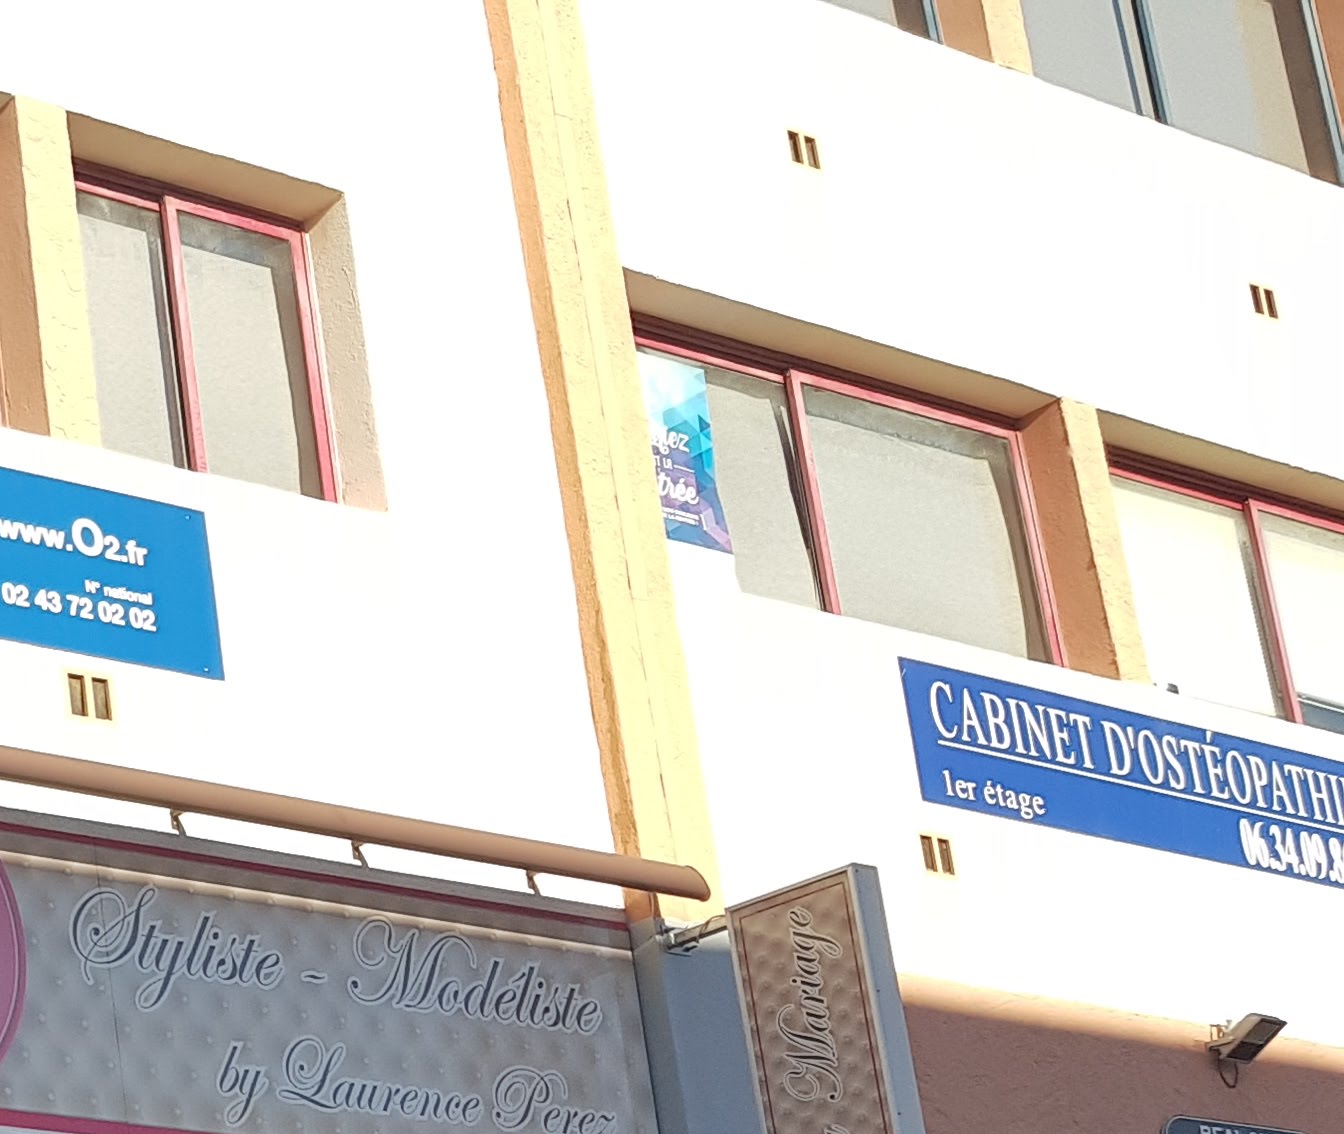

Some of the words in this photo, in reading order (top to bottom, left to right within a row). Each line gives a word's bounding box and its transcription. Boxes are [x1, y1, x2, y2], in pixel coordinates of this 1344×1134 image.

[658, 471, 700, 505] trée
[1, 581, 31, 608] 02
[34, 589, 62, 614] 43
[66, 594, 94, 620] 72
[97, 600, 126, 626] 02
[129, 606, 157, 632] 02
[103, 586, 153, 606] national
[928, 680, 1097, 770] CABINET
[1101, 719, 1344, 826] D'OSTÉOPATHI
[941, 769, 978, 801] 1er
[983, 779, 1047, 821] étage
[1239, 818, 1344, 885] 06.34.09.8
[70, 886, 283, 1011] Styliste
[348, 917, 602, 1034] Modéliste
[784, 905, 844, 1102] Mariage
[217, 1040, 267, 1126] by
[278, 1036, 480, 1126] Laurence
